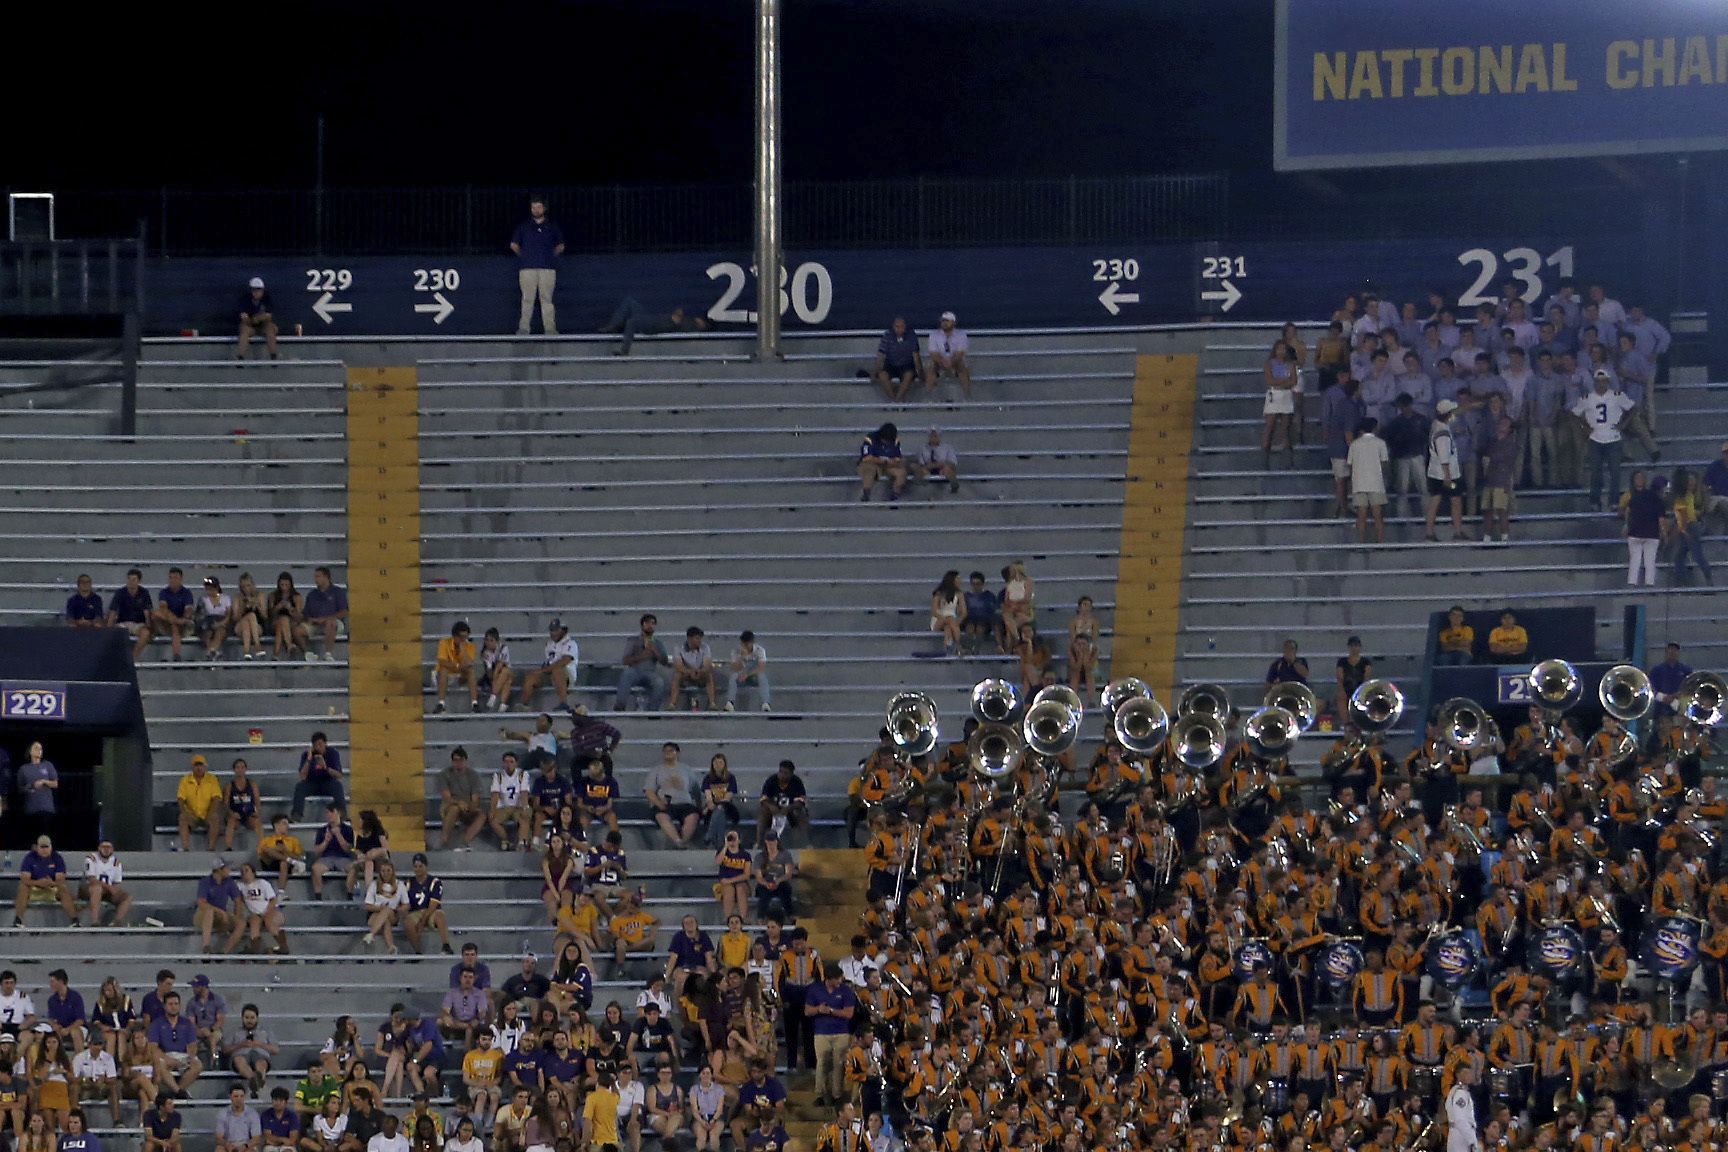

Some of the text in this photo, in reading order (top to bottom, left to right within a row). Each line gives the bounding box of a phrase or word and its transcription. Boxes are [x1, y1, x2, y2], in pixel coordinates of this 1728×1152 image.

[1313, 40, 1577, 103] NATIONAL
[1093, 259, 1139, 282] 230
[1202, 256, 1247, 279] 231
[1458, 246, 1575, 308] 231
[307, 269, 352, 292] 229
[413, 269, 460, 292] 230
[1596, 404, 1607, 423] 3
[11, 694, 56, 714] 229
[507, 786, 515, 799] 7
[3, 1008, 15, 1022] 7
[507, 1034, 516, 1051] 7
[63, 1141, 85, 1149] LSU
